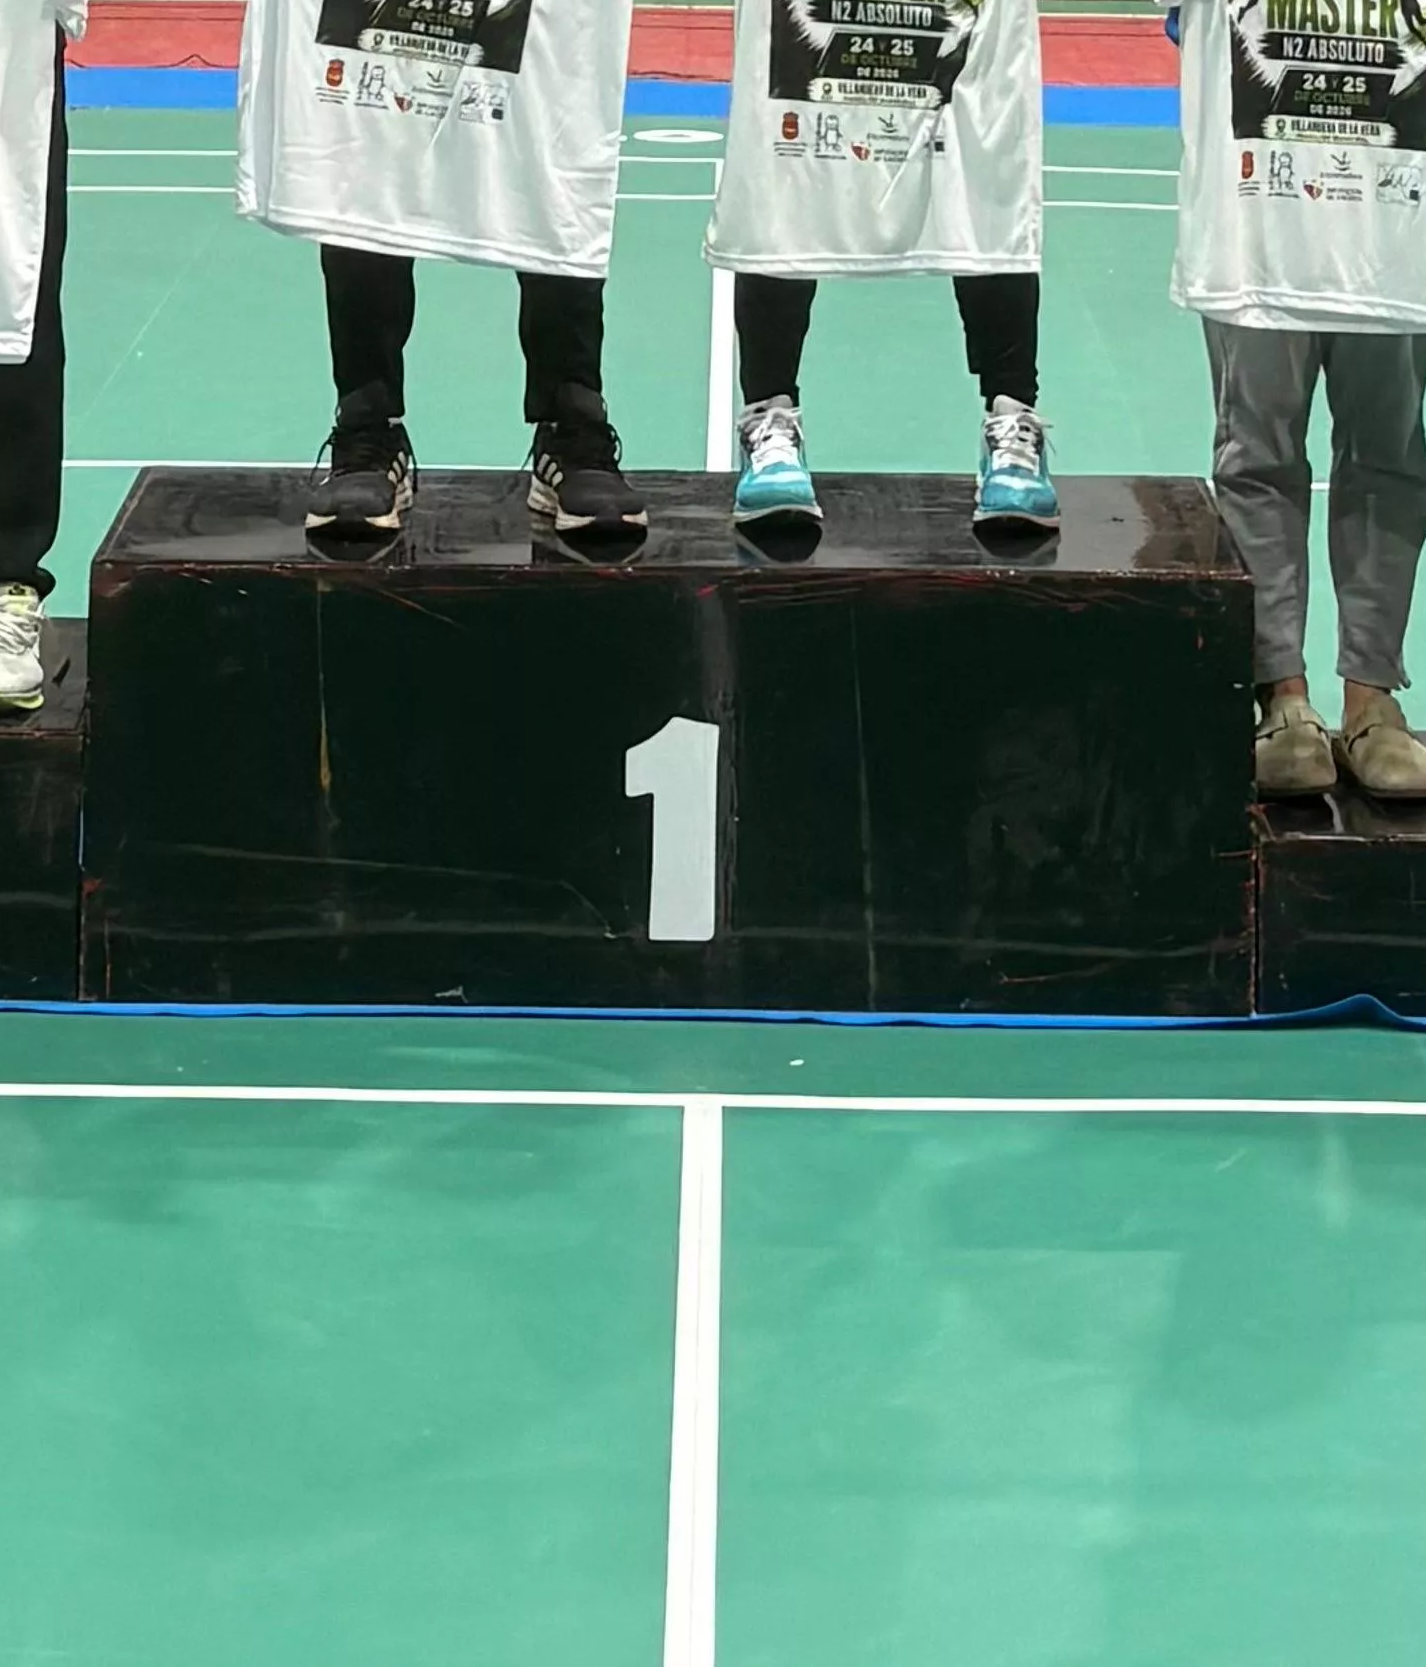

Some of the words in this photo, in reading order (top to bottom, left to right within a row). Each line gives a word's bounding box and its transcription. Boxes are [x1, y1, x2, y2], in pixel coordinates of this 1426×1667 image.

[855, 2, 933, 27] ABSOLUTO
[1282, 36, 1304, 58] N2
[1308, 38, 1385, 63] ABSOLUTO
[1303, 74, 1326, 90] 24
[1343, 78, 1366, 93] 25
[621, 721, 720, 942] 1
